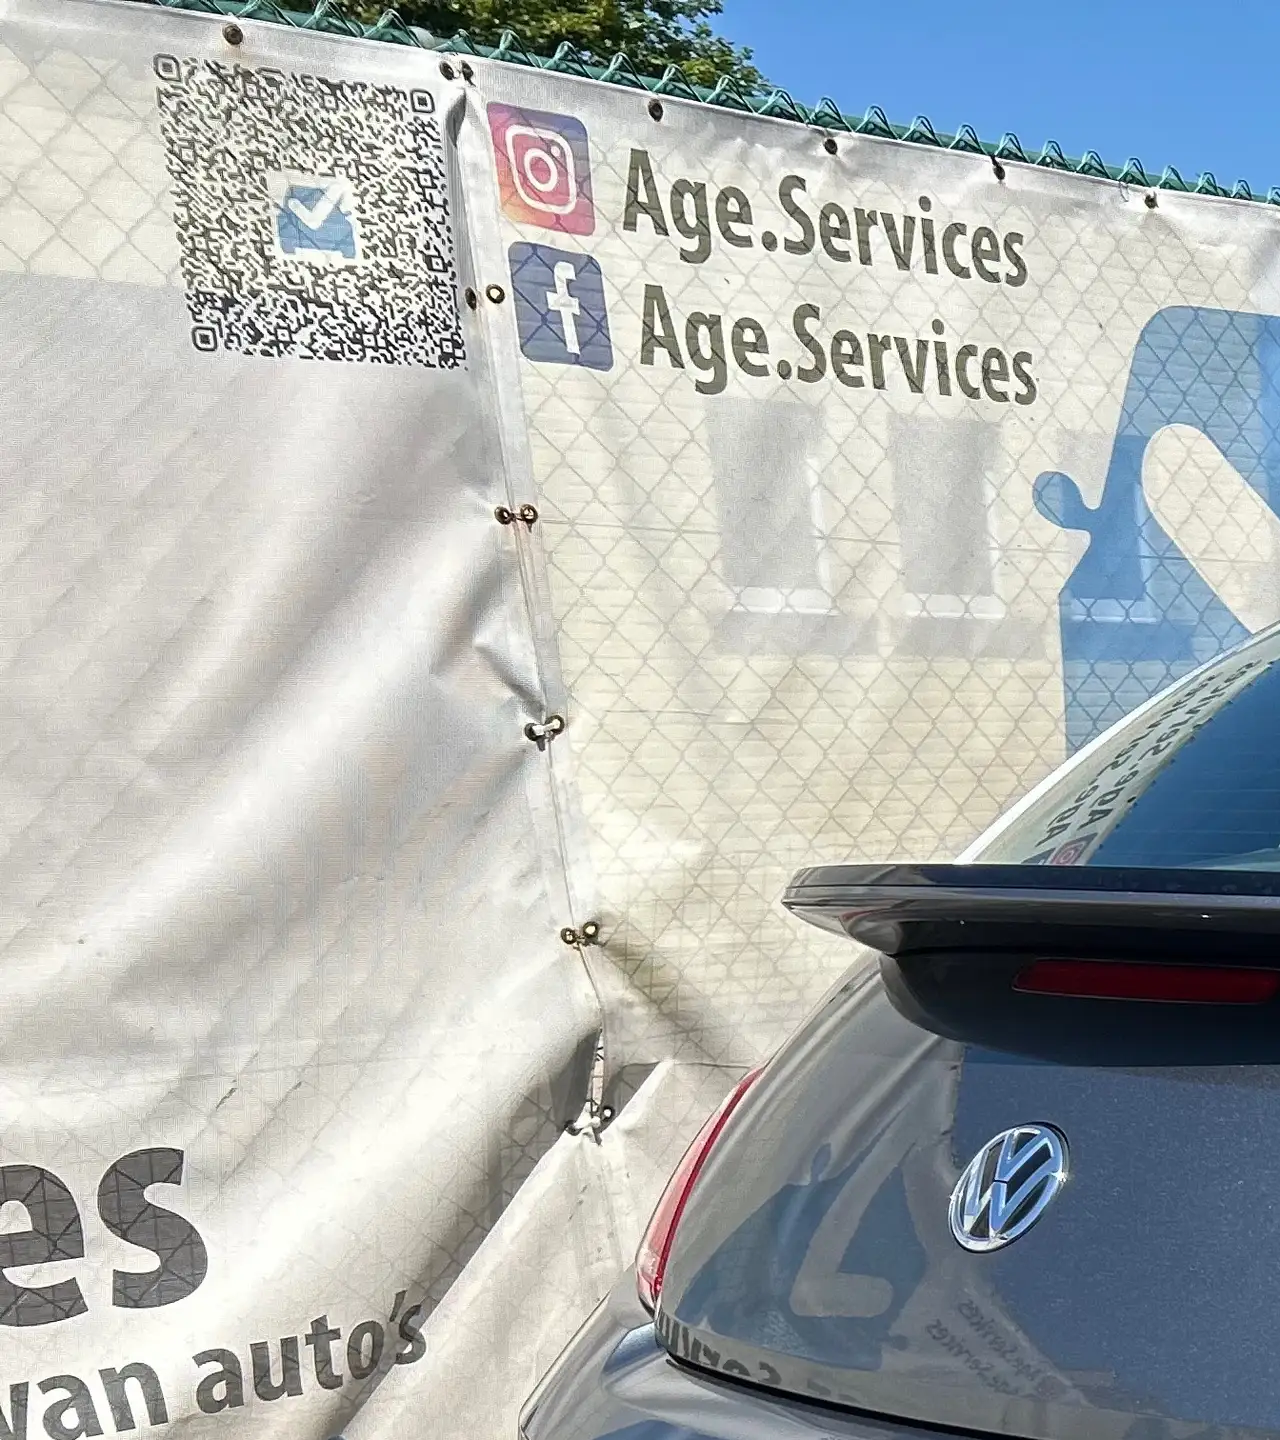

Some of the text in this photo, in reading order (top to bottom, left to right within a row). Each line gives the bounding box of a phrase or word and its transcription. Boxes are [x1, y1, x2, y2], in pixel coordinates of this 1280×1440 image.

[623, 148, 1028, 288] Age.Services
[640, 284, 1037, 405] Age.Services
[192, 1290, 427, 1415] auto's
